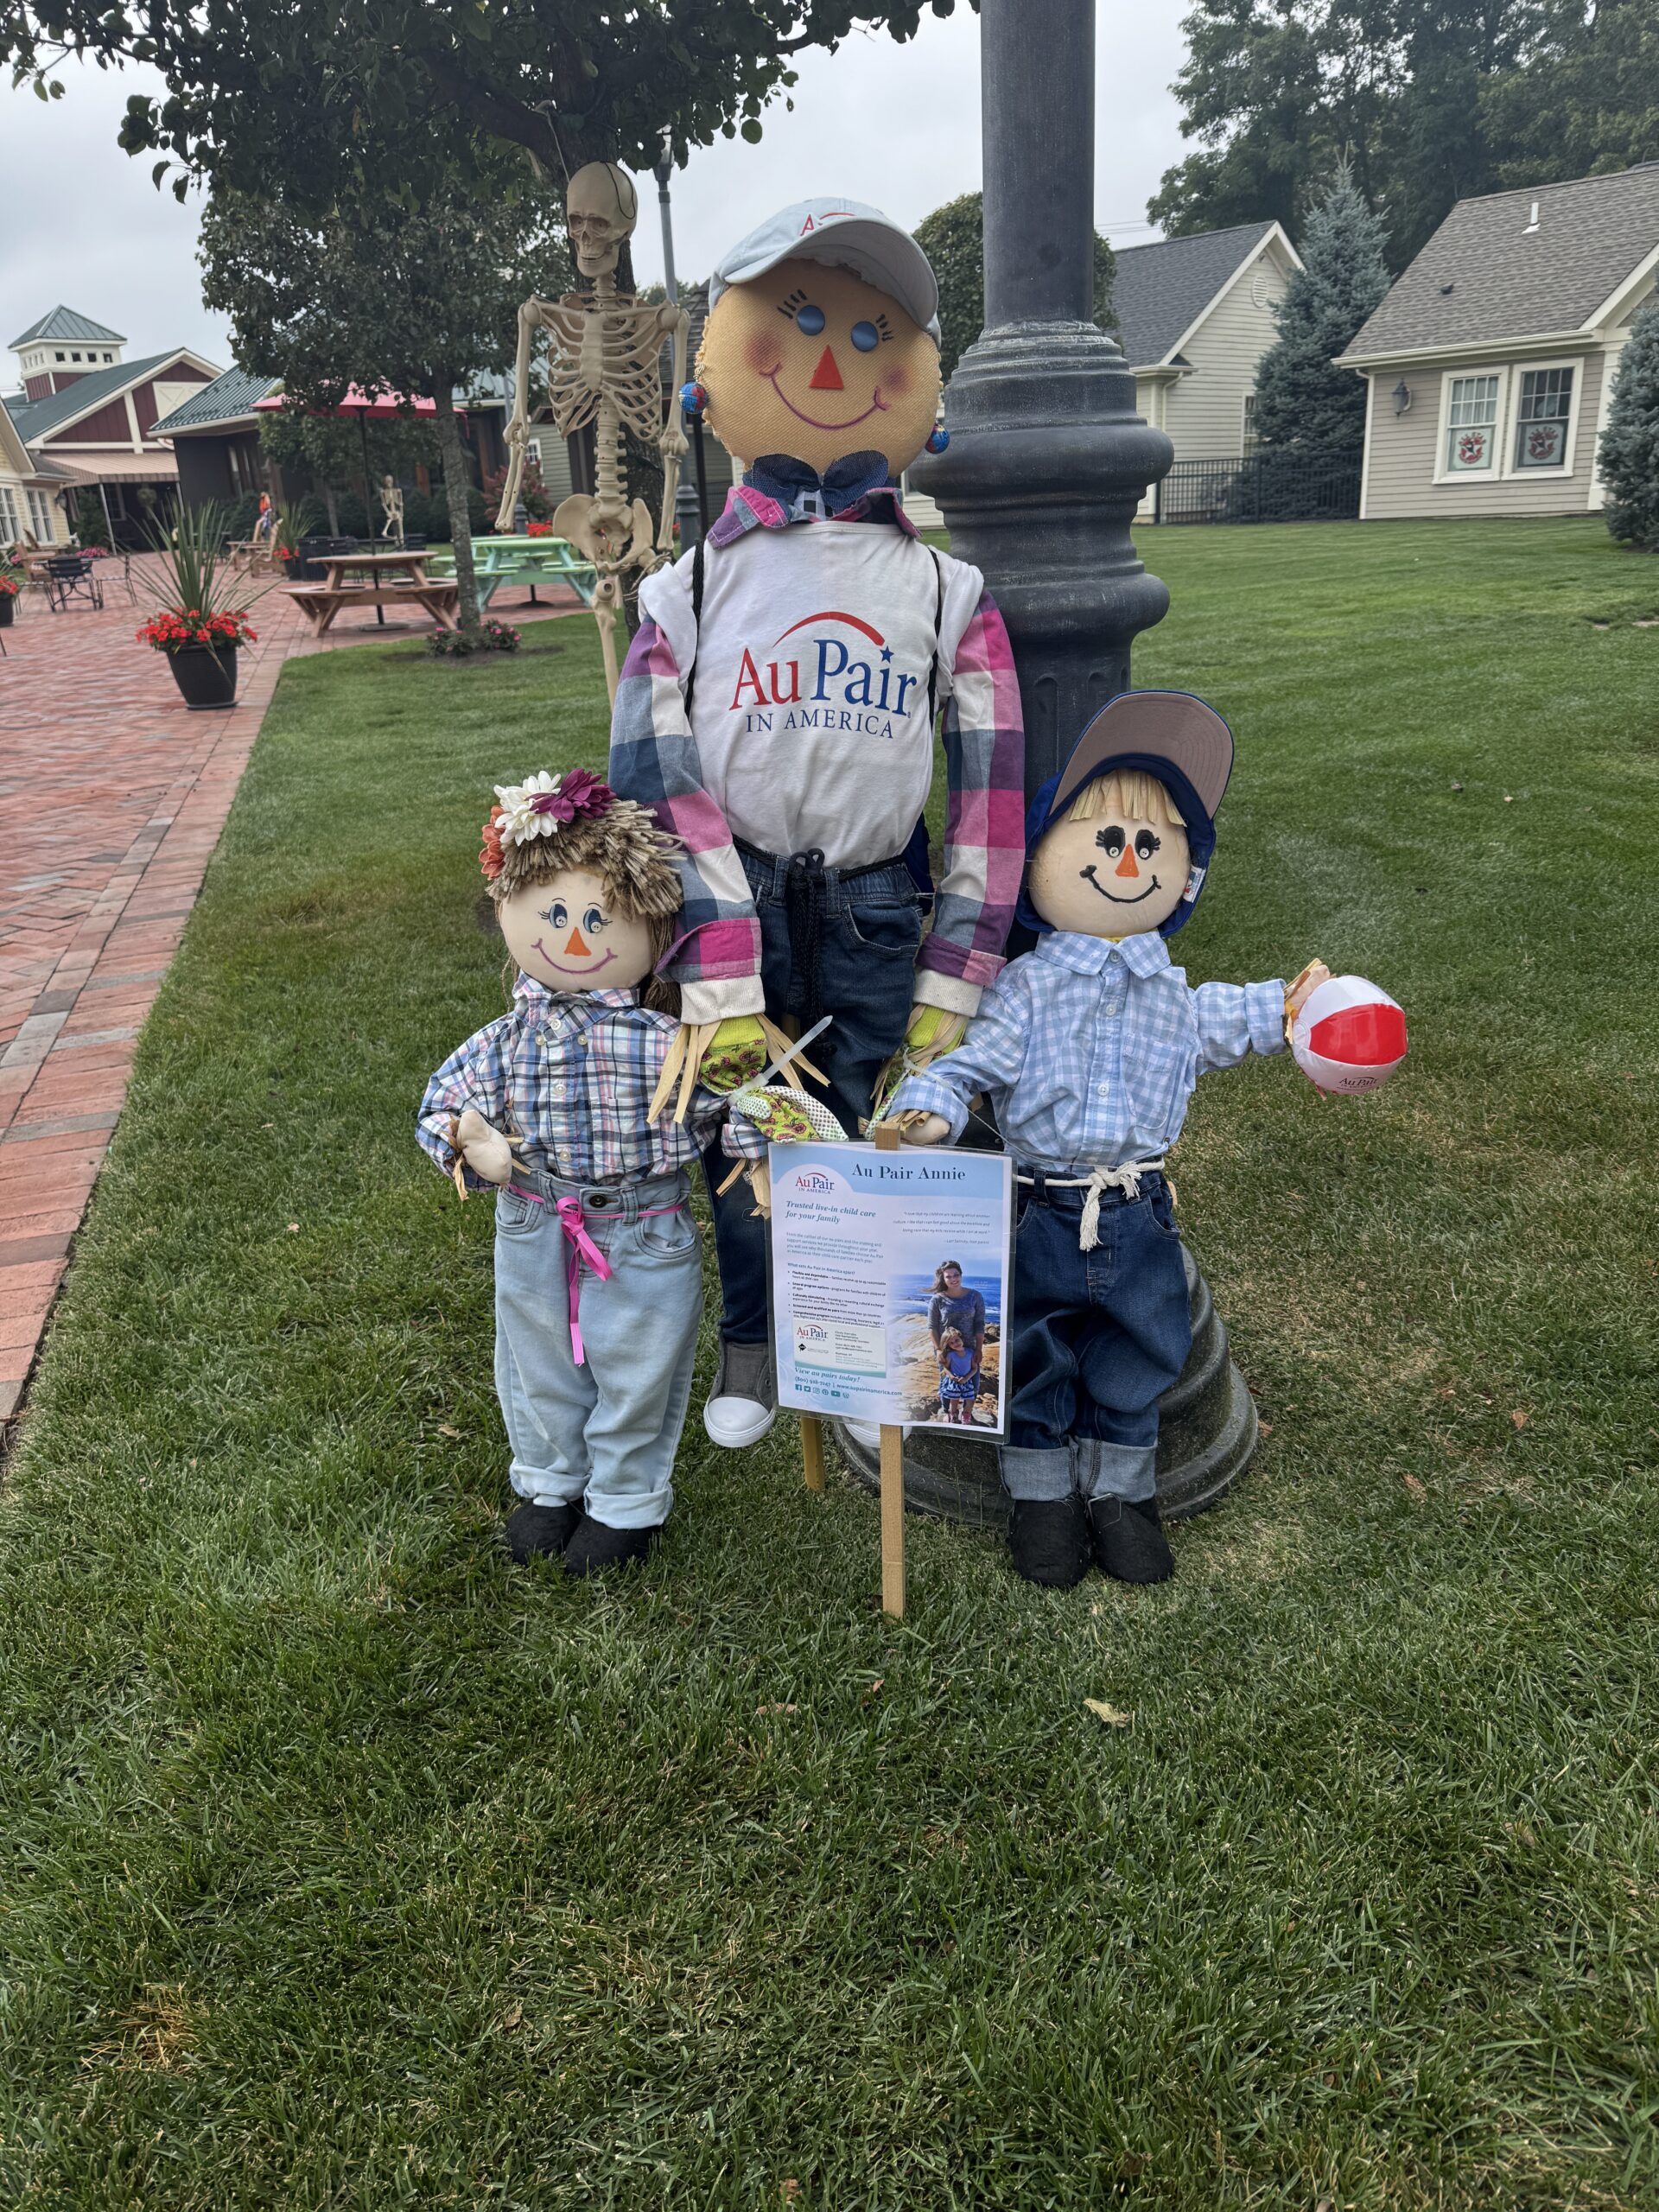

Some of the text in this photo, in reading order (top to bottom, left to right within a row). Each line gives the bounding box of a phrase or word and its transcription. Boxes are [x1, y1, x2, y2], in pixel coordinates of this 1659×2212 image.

[728, 639, 918, 716] Au Pair
[746, 709, 893, 739] IN AMERICA
[1338, 1077, 1355, 1086] Au
[852, 1163, 966, 1181] Au Pair Annie
[796, 1176, 836, 1191] Au Pair
[786, 1200, 814, 1210] Trusted
[815, 1203, 838, 1212] live-in
[840, 1206, 859, 1216] child
[798, 1212, 816, 1221] your
[816, 1213, 841, 1224] family
[797, 1326, 809, 1337] Au
[810, 1327, 829, 1338] Pair
[839, 1374, 861, 1383] today!
